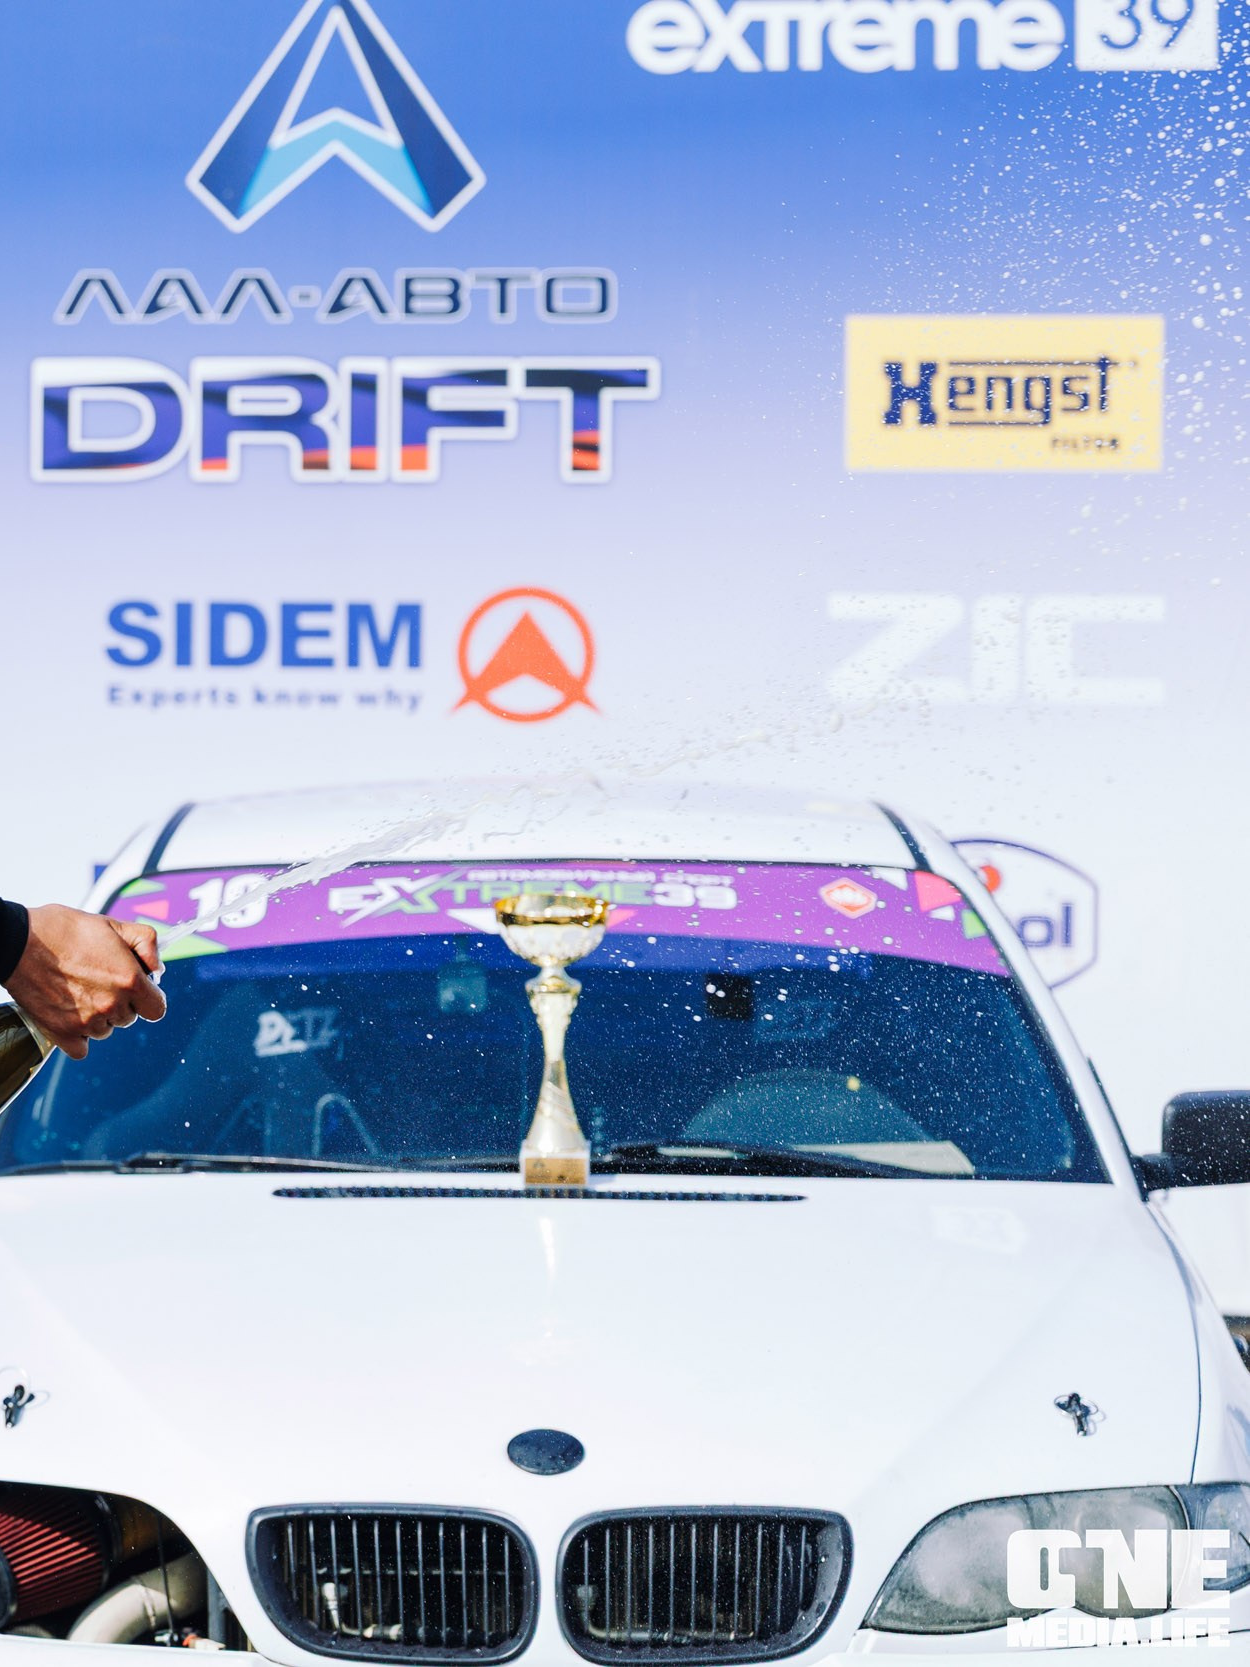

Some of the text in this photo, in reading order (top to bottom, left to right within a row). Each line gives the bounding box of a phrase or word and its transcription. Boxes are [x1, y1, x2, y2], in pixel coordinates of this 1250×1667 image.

[1098, 0, 1195, 52] 39
[32, 358, 660, 482] DRIFT
[883, 356, 1115, 426] Hengst
[106, 600, 423, 668] SIDEM
[827, 592, 1167, 705] ZIC
[107, 685, 424, 714] Experts know why
